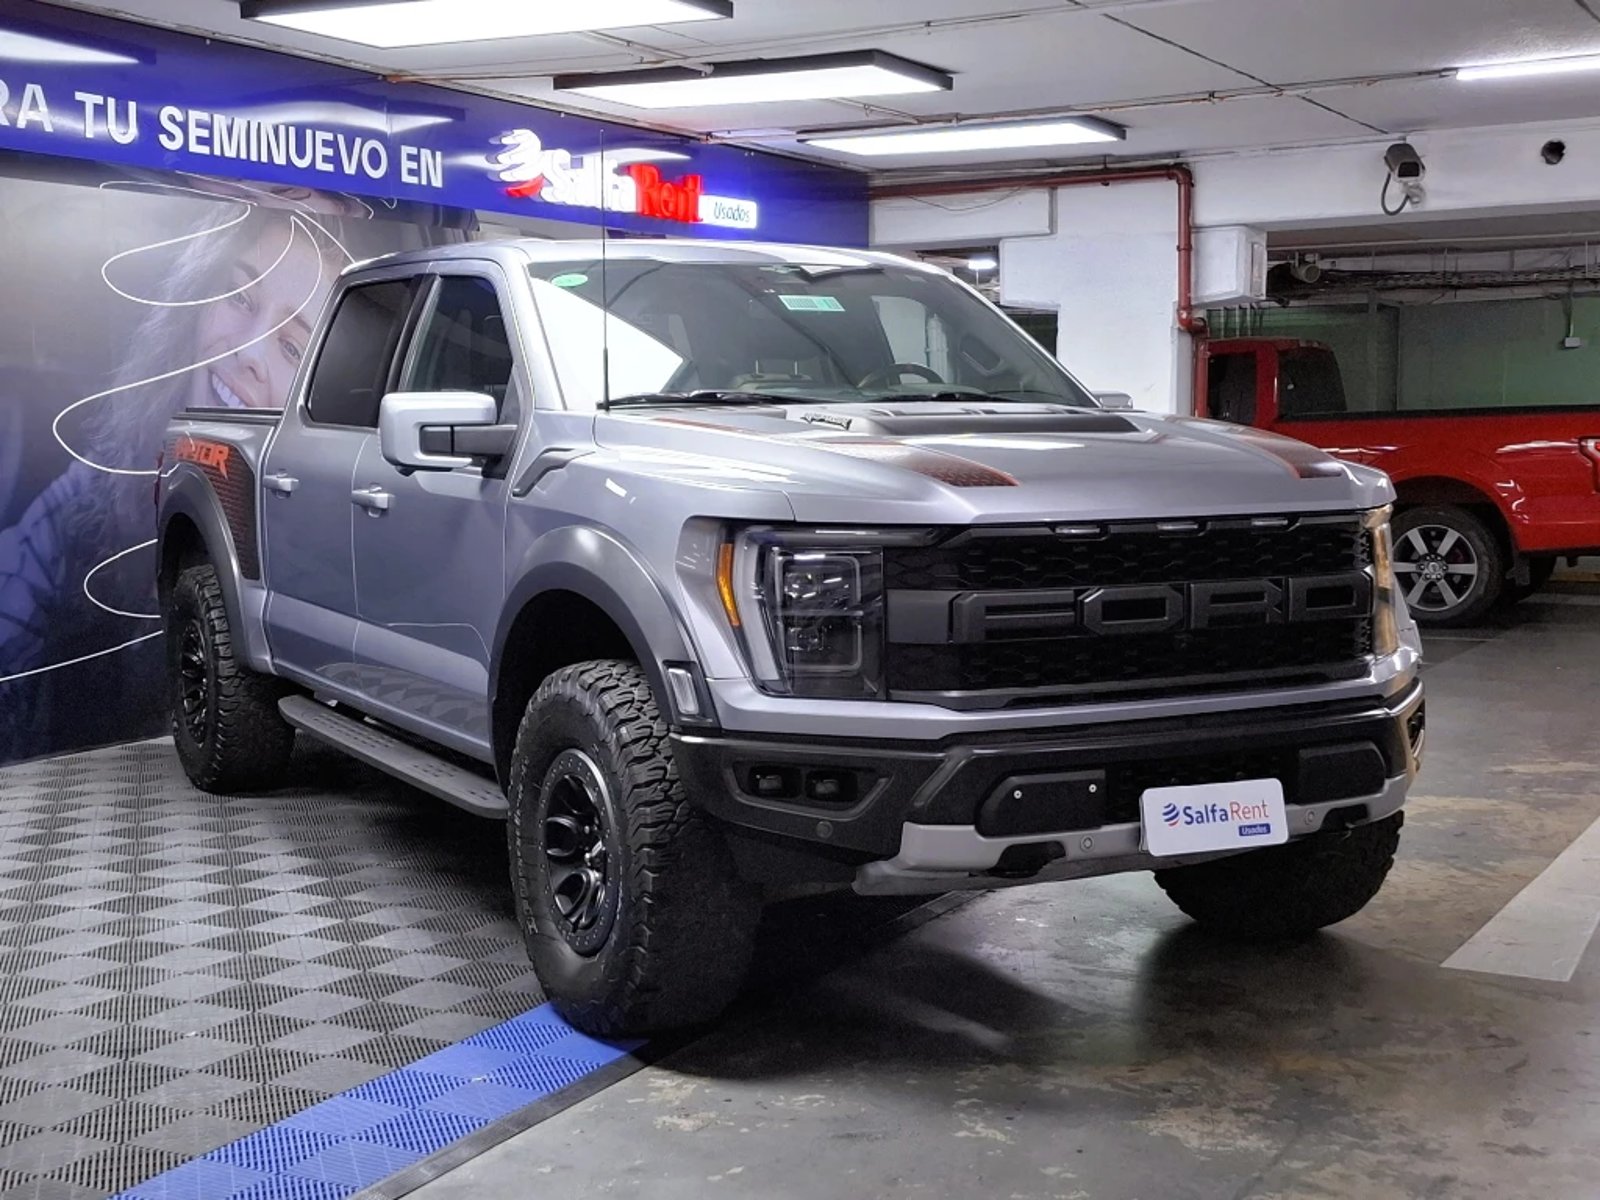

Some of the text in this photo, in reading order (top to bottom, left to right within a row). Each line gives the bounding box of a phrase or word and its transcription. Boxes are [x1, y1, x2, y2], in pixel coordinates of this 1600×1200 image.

[75, 91, 138, 145] TU
[158, 105, 389, 180] SEMINUEVO
[401, 146, 443, 188] EN
[713, 201, 751, 222] Usados
[949, 569, 1374, 643] FORD
[1182, 799, 1269, 825] SalfaRent
